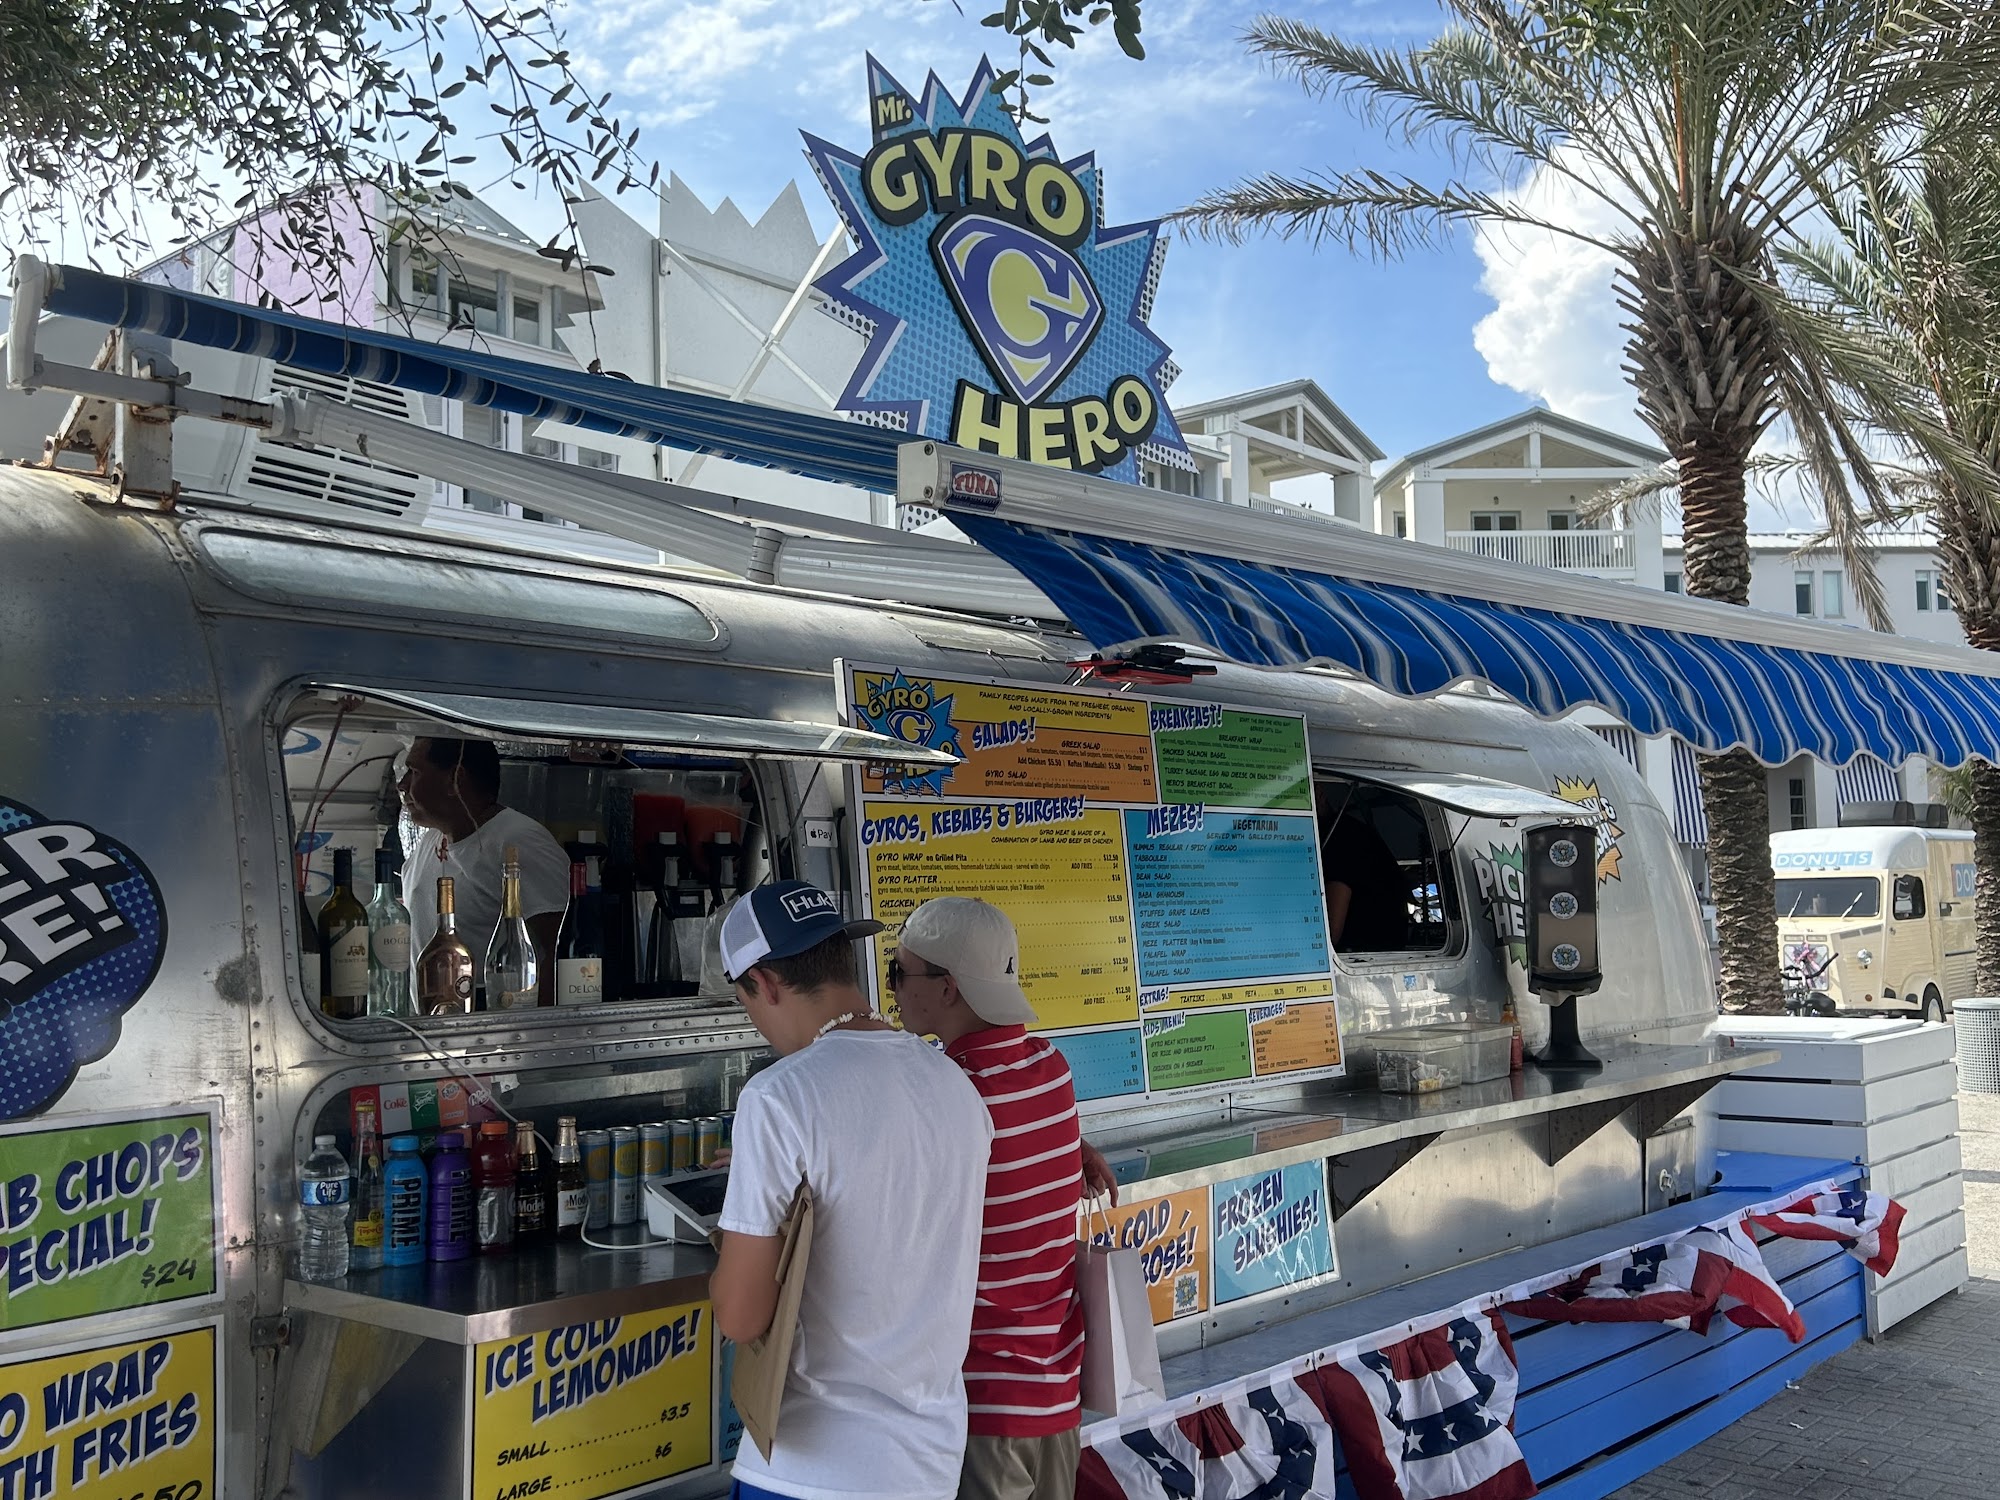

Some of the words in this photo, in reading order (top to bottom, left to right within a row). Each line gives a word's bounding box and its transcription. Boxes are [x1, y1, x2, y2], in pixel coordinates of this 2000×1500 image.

[877, 95, 913, 127] Mr.
[868, 132, 1087, 238] GYRO
[958, 380, 1155, 470] HERO
[954, 473, 997, 497] TUNA
[867, 688, 929, 718] GYRO
[979, 691, 1001, 700] FAMILY
[1002, 693, 1029, 703] RECIPES
[1030, 697, 1049, 705] MADE
[1050, 698, 1068, 707] FROM
[1069, 700, 1080, 708] THE
[1111, 704, 1136, 714] ORGANIC
[1008, 704, 1022, 712] AND
[1023, 704, 1074, 717] LOCALLY-GROWN
[1150, 704, 1223, 731] BREAKFAST!
[972, 717, 1036, 749] SALADS!
[1061, 740, 1082, 749] GREEK
[1083, 741, 1101, 750] SALAD
[1218, 734, 1247, 744] BREAKFAST
[1249, 736, 1263, 745] WRAP
[1162, 748, 1185, 757] SMOKED
[1187, 749, 1208, 759] SALMON
[1210, 751, 1227, 760] BAGEL
[1018, 757, 1027, 765] Add
[1028, 757, 1047, 766] Chicken
[985, 769, 1005, 778] GYRO
[1007, 770, 1028, 779] SALAD
[1165, 767, 1184, 776] TURKEY
[1187, 780, 1217, 789] BREAKFAST
[1218, 781, 1233, 790] BOWL
[862, 814, 927, 847] GYROS,
[932, 804, 992, 837] KEBABS
[997, 804, 1010, 829] &
[1014, 795, 1085, 826] BURGERS!
[1146, 802, 1205, 837] MEZES!
[1232, 819, 1279, 831] VEGETARIAN
[817, 828, 833, 841] Pay
[1077, 829, 1093, 837] MADE
[1206, 832, 1230, 840] SERVED
[1248, 833, 1272, 841] GRILLED
[991, 836, 1029, 844] COMBINATION
[1039, 836, 1055, 844] LAMB
[1092, 837, 1113, 845] CHICKEN
[1133, 843, 1155, 851] HUMMUS
[1159, 843, 1183, 851] REGULAR
[1190, 843, 1206, 851] SPICY
[1214, 844, 1238, 852] AVOCADO
[876, 853, 899, 862] GYRO
[902, 853, 923, 861] WRAP
[935, 853, 954, 861] Grilled
[955, 853, 967, 861] Pita
[1103, 854, 1119, 862] $12.50
[1134, 854, 1168, 862] TABBOULEH
[1776, 852, 1871, 866] DONUTS
[876, 864, 887, 873] gyro
[961, 863, 984, 871] homemade
[1080, 862, 1093, 870] FRIES
[877, 876, 901, 885] GYRO
[903, 875, 938, 884] PLATTER
[1136, 872, 1151, 880] BEAN
[1154, 872, 1172, 880] SALAD
[877, 888, 888, 896] gyro
[915, 886, 930, 895] grilled
[955, 885, 979, 893] homemade
[1138, 891, 1153, 899] BABA
[789, 893, 833, 913] Huk
[880, 899, 915, 908] CHICKEN
[1109, 915, 1125, 923] $15.50
[1140, 909, 1165, 918] STUFFED
[1168, 909, 1187, 917] GRAPE
[1189, 908, 1211, 916] LEAVES
[1141, 921, 1160, 929] GREEK
[1164, 920, 1181, 928] SALAD
[1143, 940, 1158, 948] MEZE
[1162, 938, 1188, 946] PLATTER
[1144, 950, 1168, 959] FALAFEL
[1113, 957, 1129, 965] $12.50
[1081, 967, 1090, 975] ADD
[1090, 967, 1103, 975] FRIES
[1145, 969, 1169, 978] FALAFEL
[1173, 968, 1191, 976] SALAD
[569, 984, 581, 993] DE
[1084, 997, 1093, 1005] ADD
[1093, 996, 1106, 1004] FRIES
[1139, 986, 1169, 1007] EXTRAS!
[1245, 990, 1257, 998] FETA
[1248, 1001, 1286, 1025] BEVERAGES!
[1143, 1020, 1161, 1037] KIDS
[1161, 1011, 1185, 1032] MENU!
[383, 1098, 407, 1110] Coke
[56, 1127, 203, 1215] CHOPS
[320, 1181, 338, 1190] Pure
[322, 1188, 337, 1198] Life
[1218, 1169, 1284, 1241] FROZEN
[391, 1176, 422, 1249] PRIME
[1121, 1199, 1172, 1250] COLD
[357, 1226, 377, 1237] Topo
[1234, 1189, 1320, 1274] SLUSHIES!
[141, 1258, 197, 1289] $24
[484, 1335, 535, 1397] ICE
[544, 1316, 625, 1369] COLD
[532, 1309, 703, 1425] LEMONADE!
[43, 1341, 172, 1436] WRAP
[72, 1392, 200, 1490] FRIES
[497, 1441, 550, 1467] SMALL
[660, 1403, 691, 1423] $3.5
[497, 1476, 553, 1500] LARGE
[655, 1442, 673, 1459] $6
